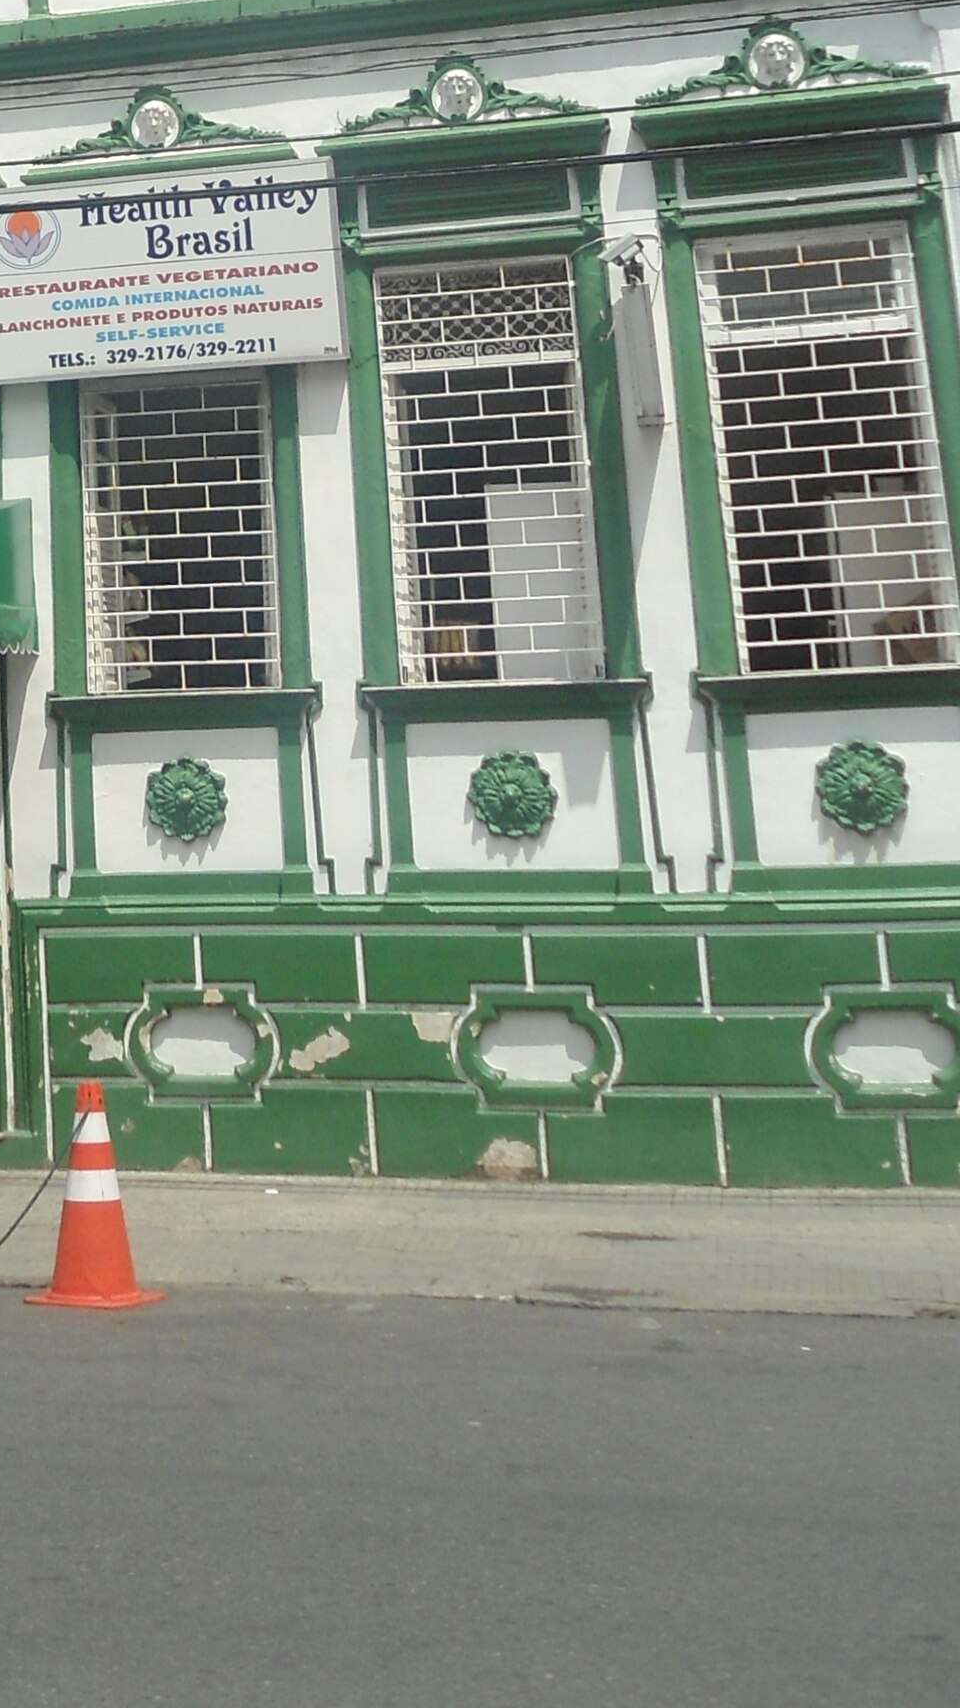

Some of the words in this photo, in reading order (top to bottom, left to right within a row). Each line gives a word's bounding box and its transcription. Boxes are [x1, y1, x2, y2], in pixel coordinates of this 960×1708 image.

[78, 184, 193, 227] Health
[202, 175, 318, 215] Valley
[145, 216, 254, 259] Brasil
[156, 261, 319, 284] VEGETARIANO
[51, 295, 120, 311] COMIDA
[125, 284, 264, 305] INTERNACIONAL
[117, 313, 126, 323] E
[132, 305, 228, 323] PRODUTOS
[233, 297, 323, 315] NATURAIS
[95, 322, 225, 343] SELF-SERVICE
[49, 352, 96, 368] TELS.:
[106, 337, 276, 365] 329-2176/329-2211
